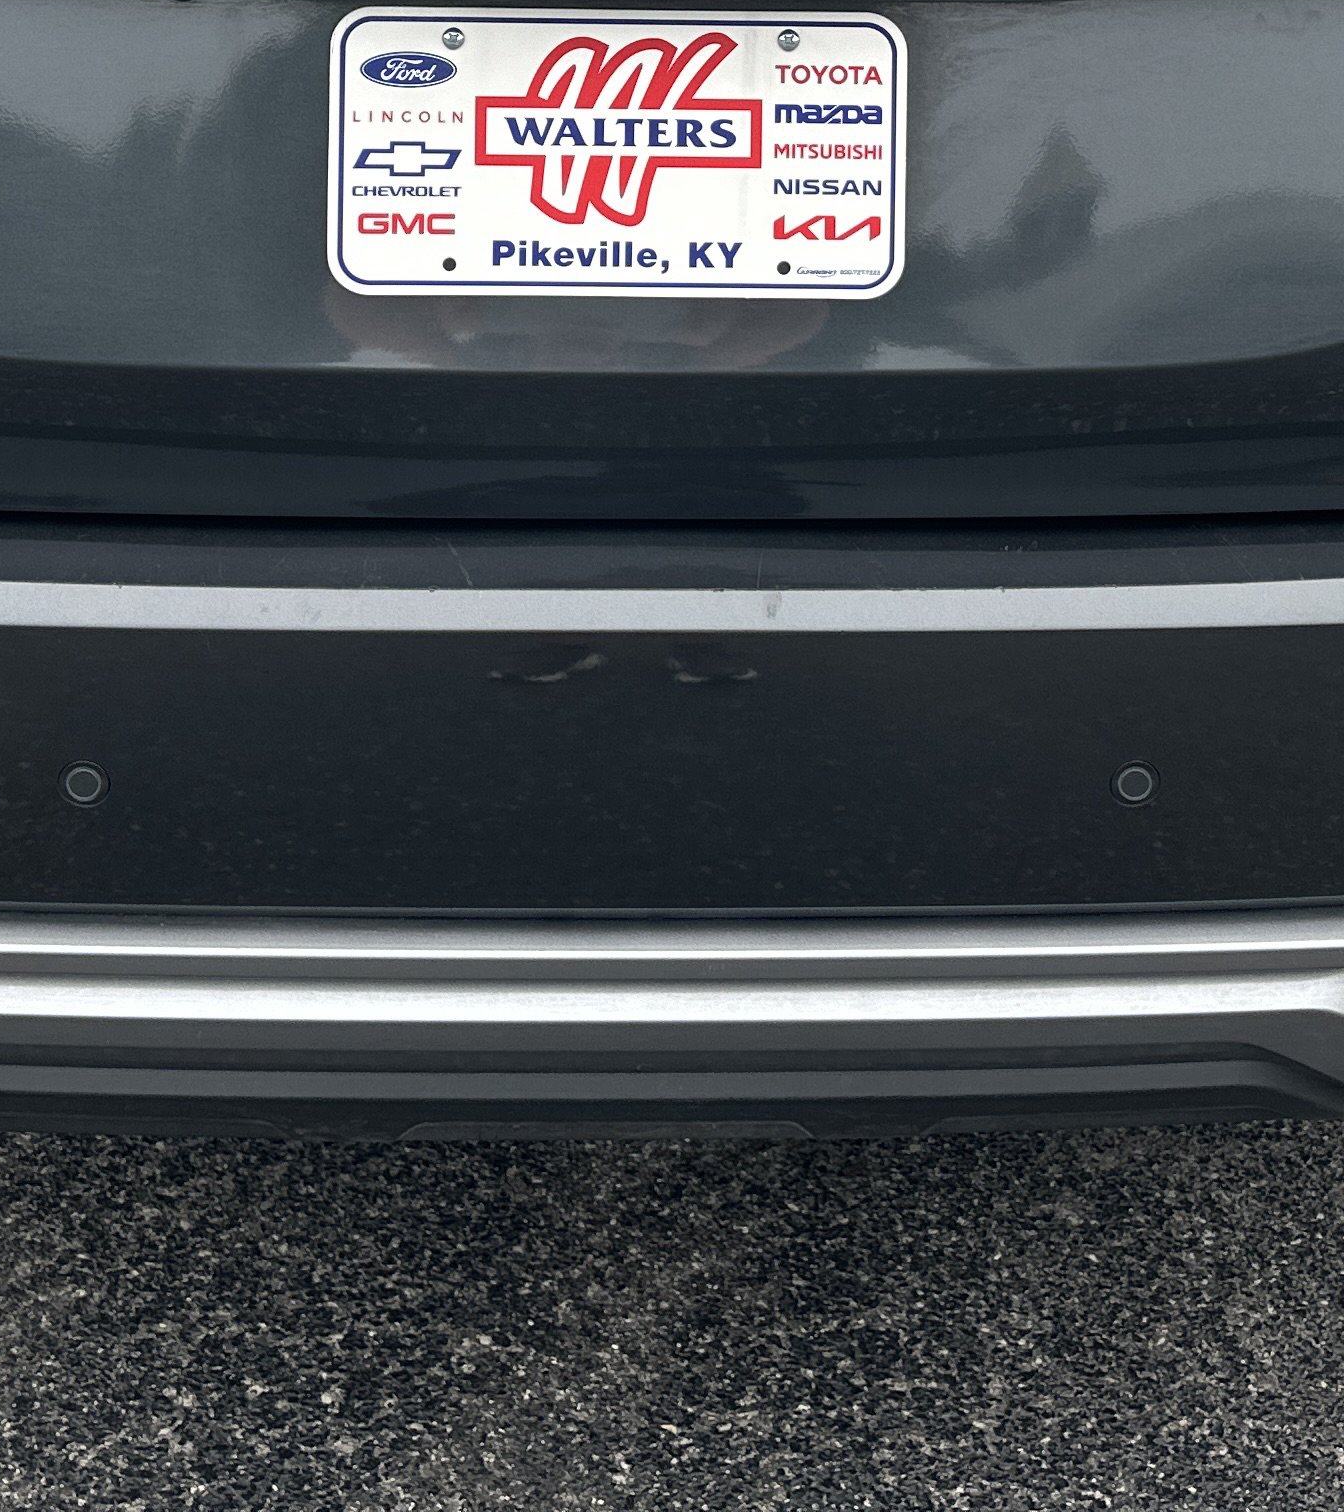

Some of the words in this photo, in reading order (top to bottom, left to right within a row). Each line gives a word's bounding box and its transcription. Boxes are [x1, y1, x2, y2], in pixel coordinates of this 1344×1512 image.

[380, 57, 438, 81] Ford
[775, 64, 883, 85] TOYOTA
[352, 110, 464, 124] LINCOLN
[504, 117, 737, 149] WALTERS
[773, 143, 883, 160] MITSUBISHI
[351, 185, 462, 198] CHEVROLET
[773, 178, 882, 196] NISSAN
[358, 212, 456, 235] GMC
[491, 239, 670, 275] Pikeville,
[688, 241, 743, 269] KY
